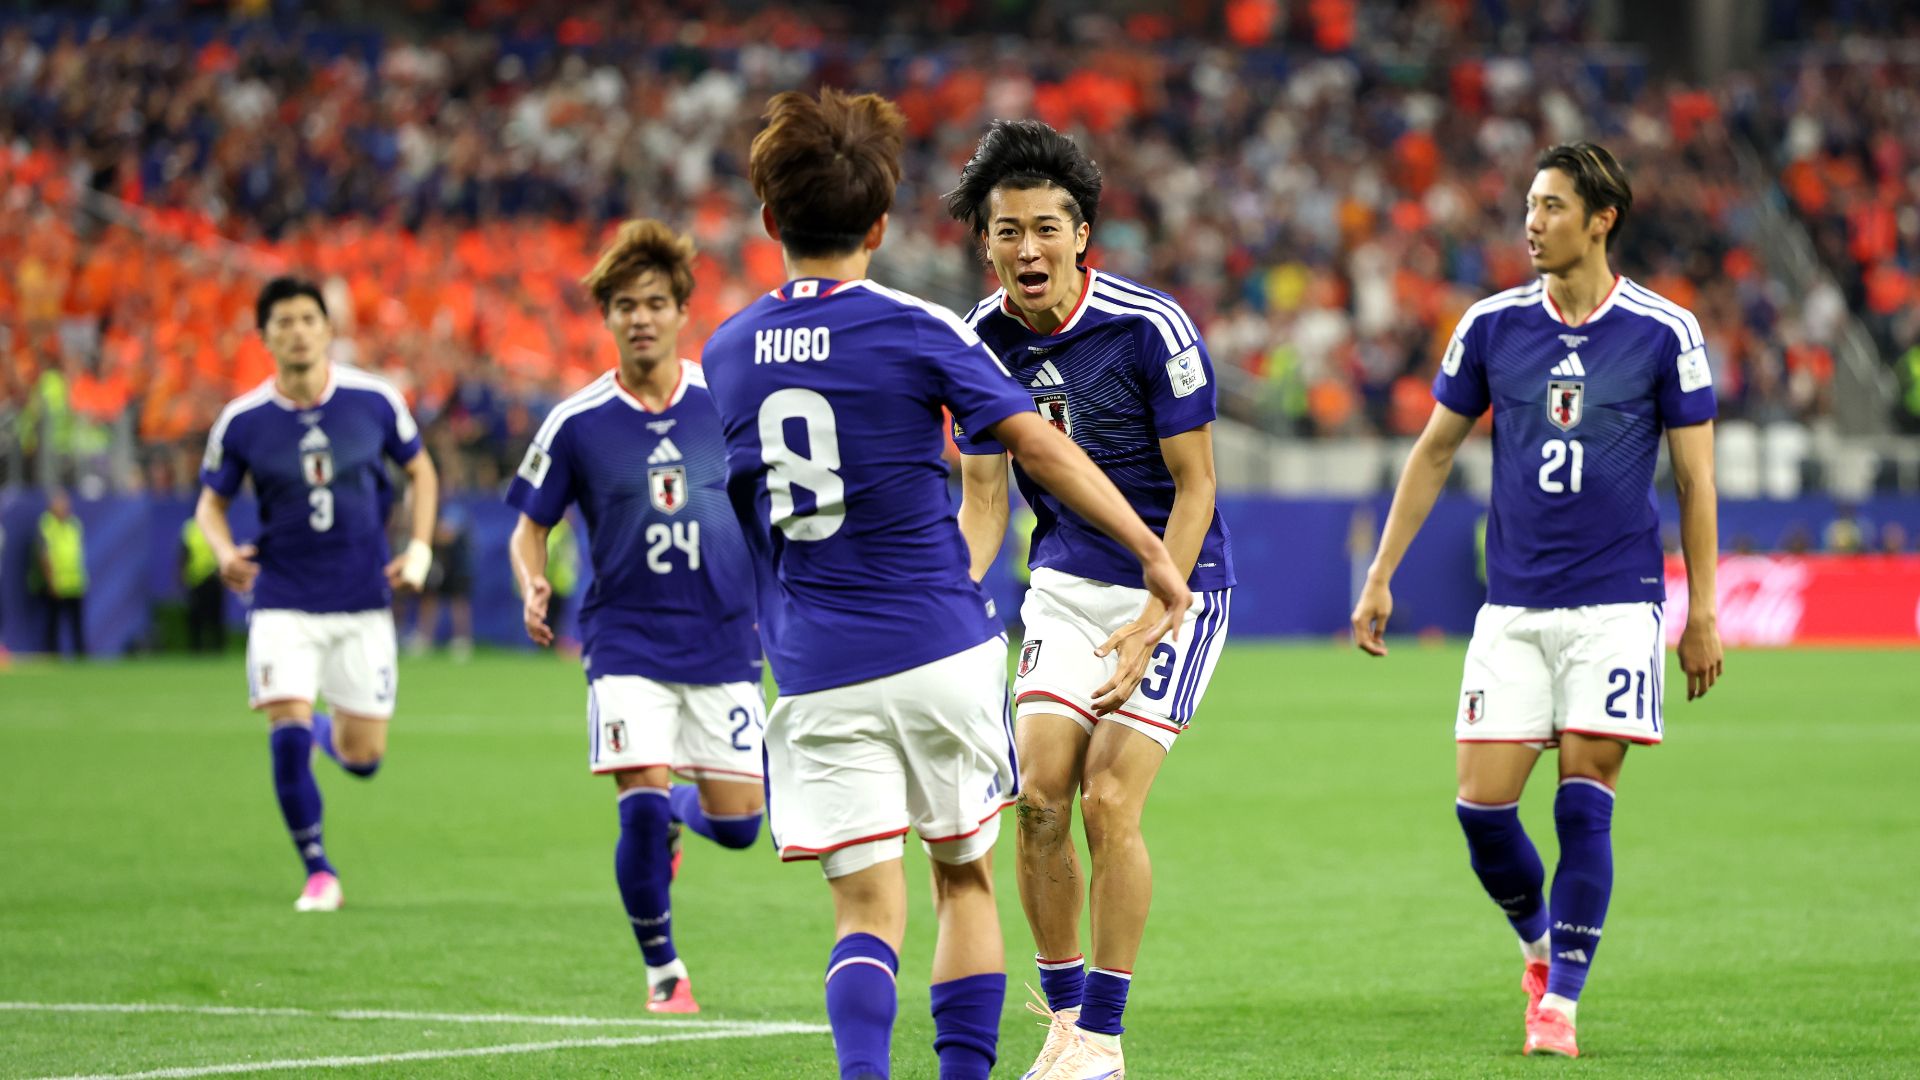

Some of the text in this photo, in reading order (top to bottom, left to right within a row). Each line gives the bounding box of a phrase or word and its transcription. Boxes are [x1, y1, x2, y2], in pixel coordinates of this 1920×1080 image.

[754, 326, 830, 365] KUBO
[1043, 394, 1061, 402] JAPAN
[758, 387, 846, 541] 8
[1538, 438, 1584, 494] 21
[308, 487, 334, 533] 3
[645, 519, 701, 575] 24
[1605, 668, 1645, 720] 21
